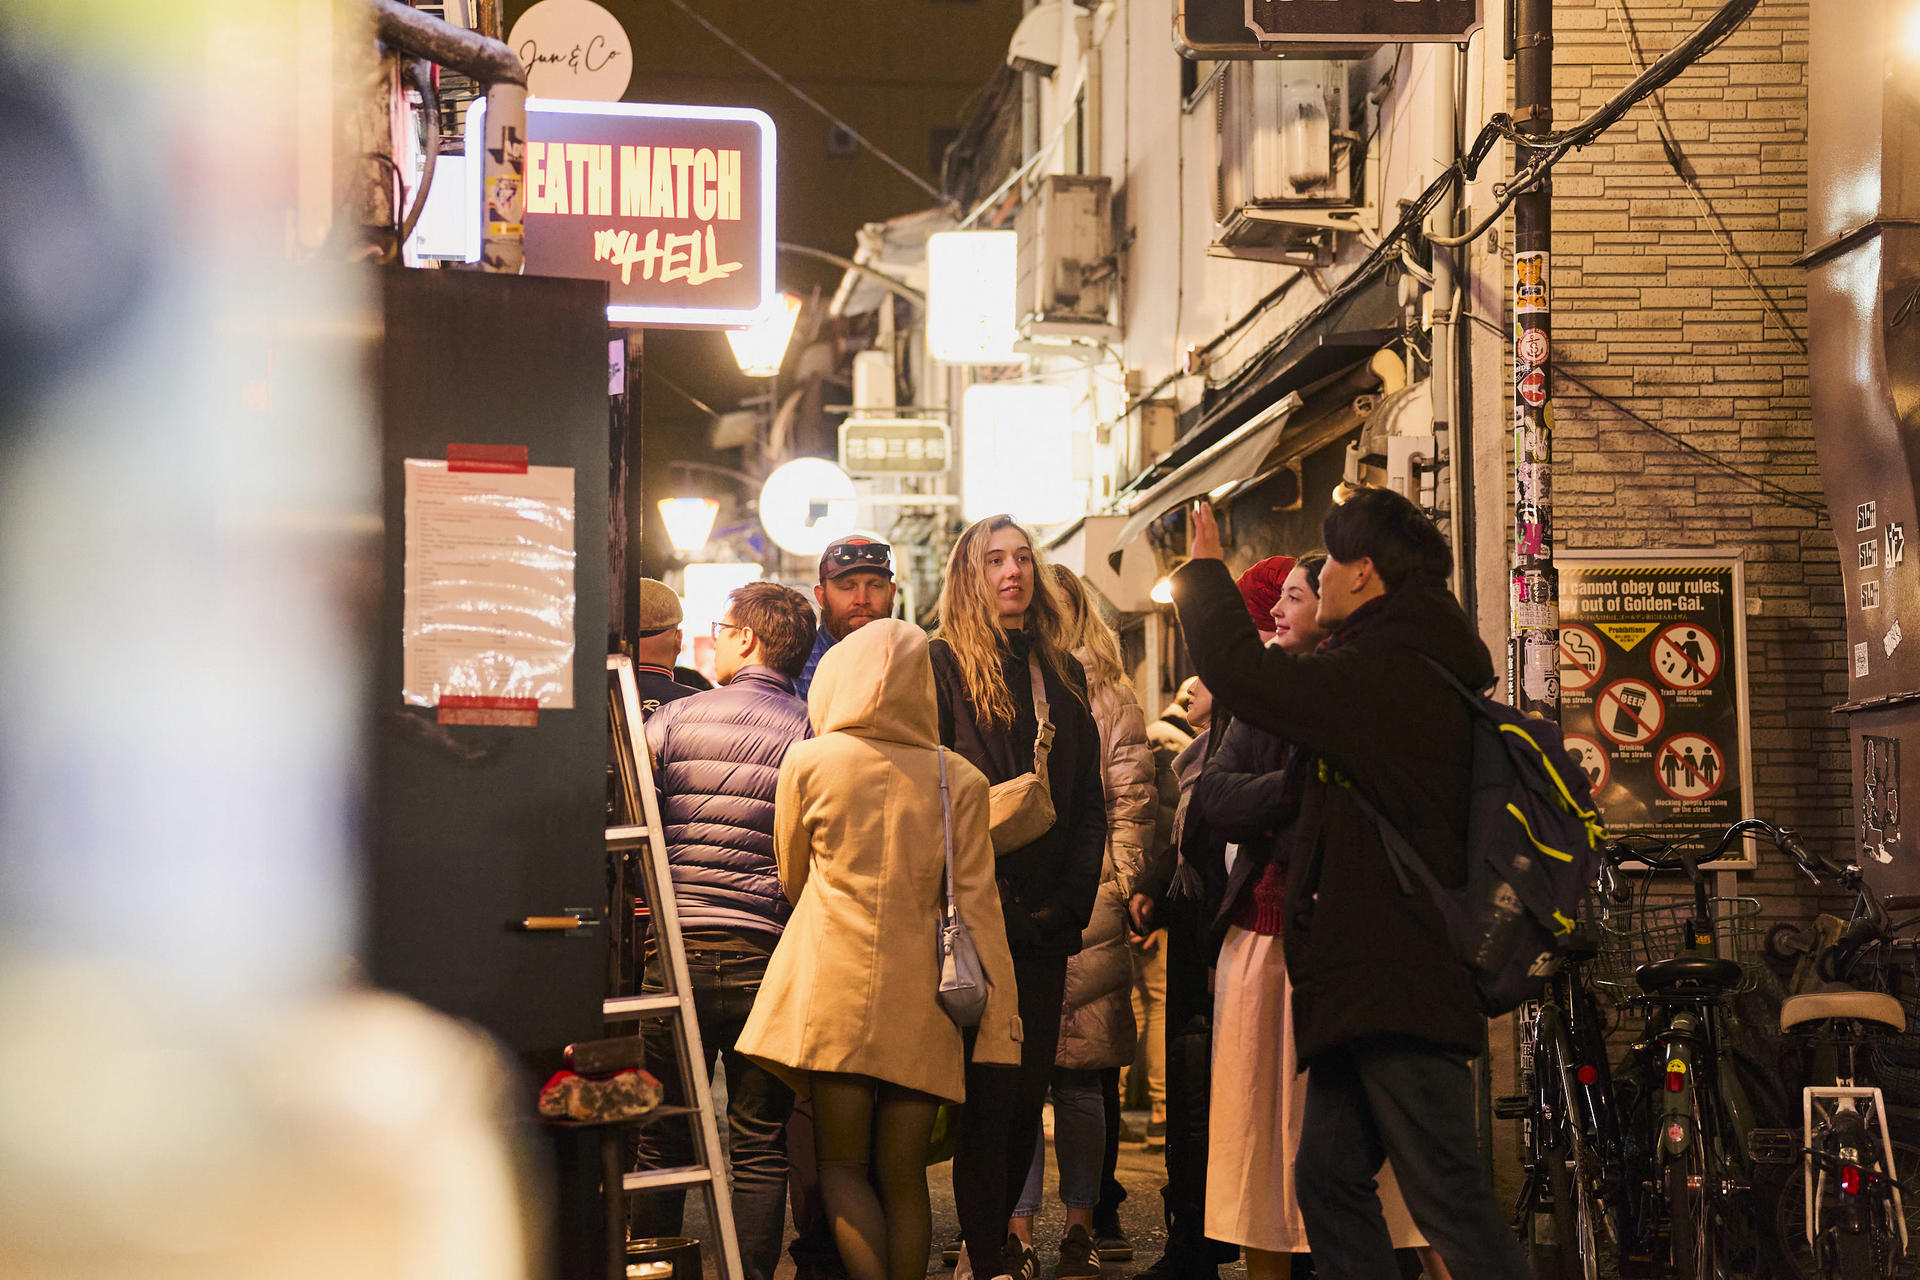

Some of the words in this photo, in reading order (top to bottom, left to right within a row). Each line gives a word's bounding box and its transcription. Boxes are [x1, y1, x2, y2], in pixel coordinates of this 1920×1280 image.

[519, 39, 567, 76] Jun
[568, 44, 582, 74] &
[585, 35, 621, 72] Co
[527, 141, 613, 216] EATH
[620, 145, 742, 221] MATCH
[611, 224, 744, 285] HELL
[1572, 580, 1617, 596] cannot
[1621, 579, 1654, 596] obey
[1658, 581, 1681, 594] our
[1684, 578, 1724, 596] rules,
[1581, 597, 1604, 612] out
[1606, 596, 1620, 612] of
[1624, 595, 1705, 612] Golden-Gai.
[1620, 693, 1645, 708] BEER
